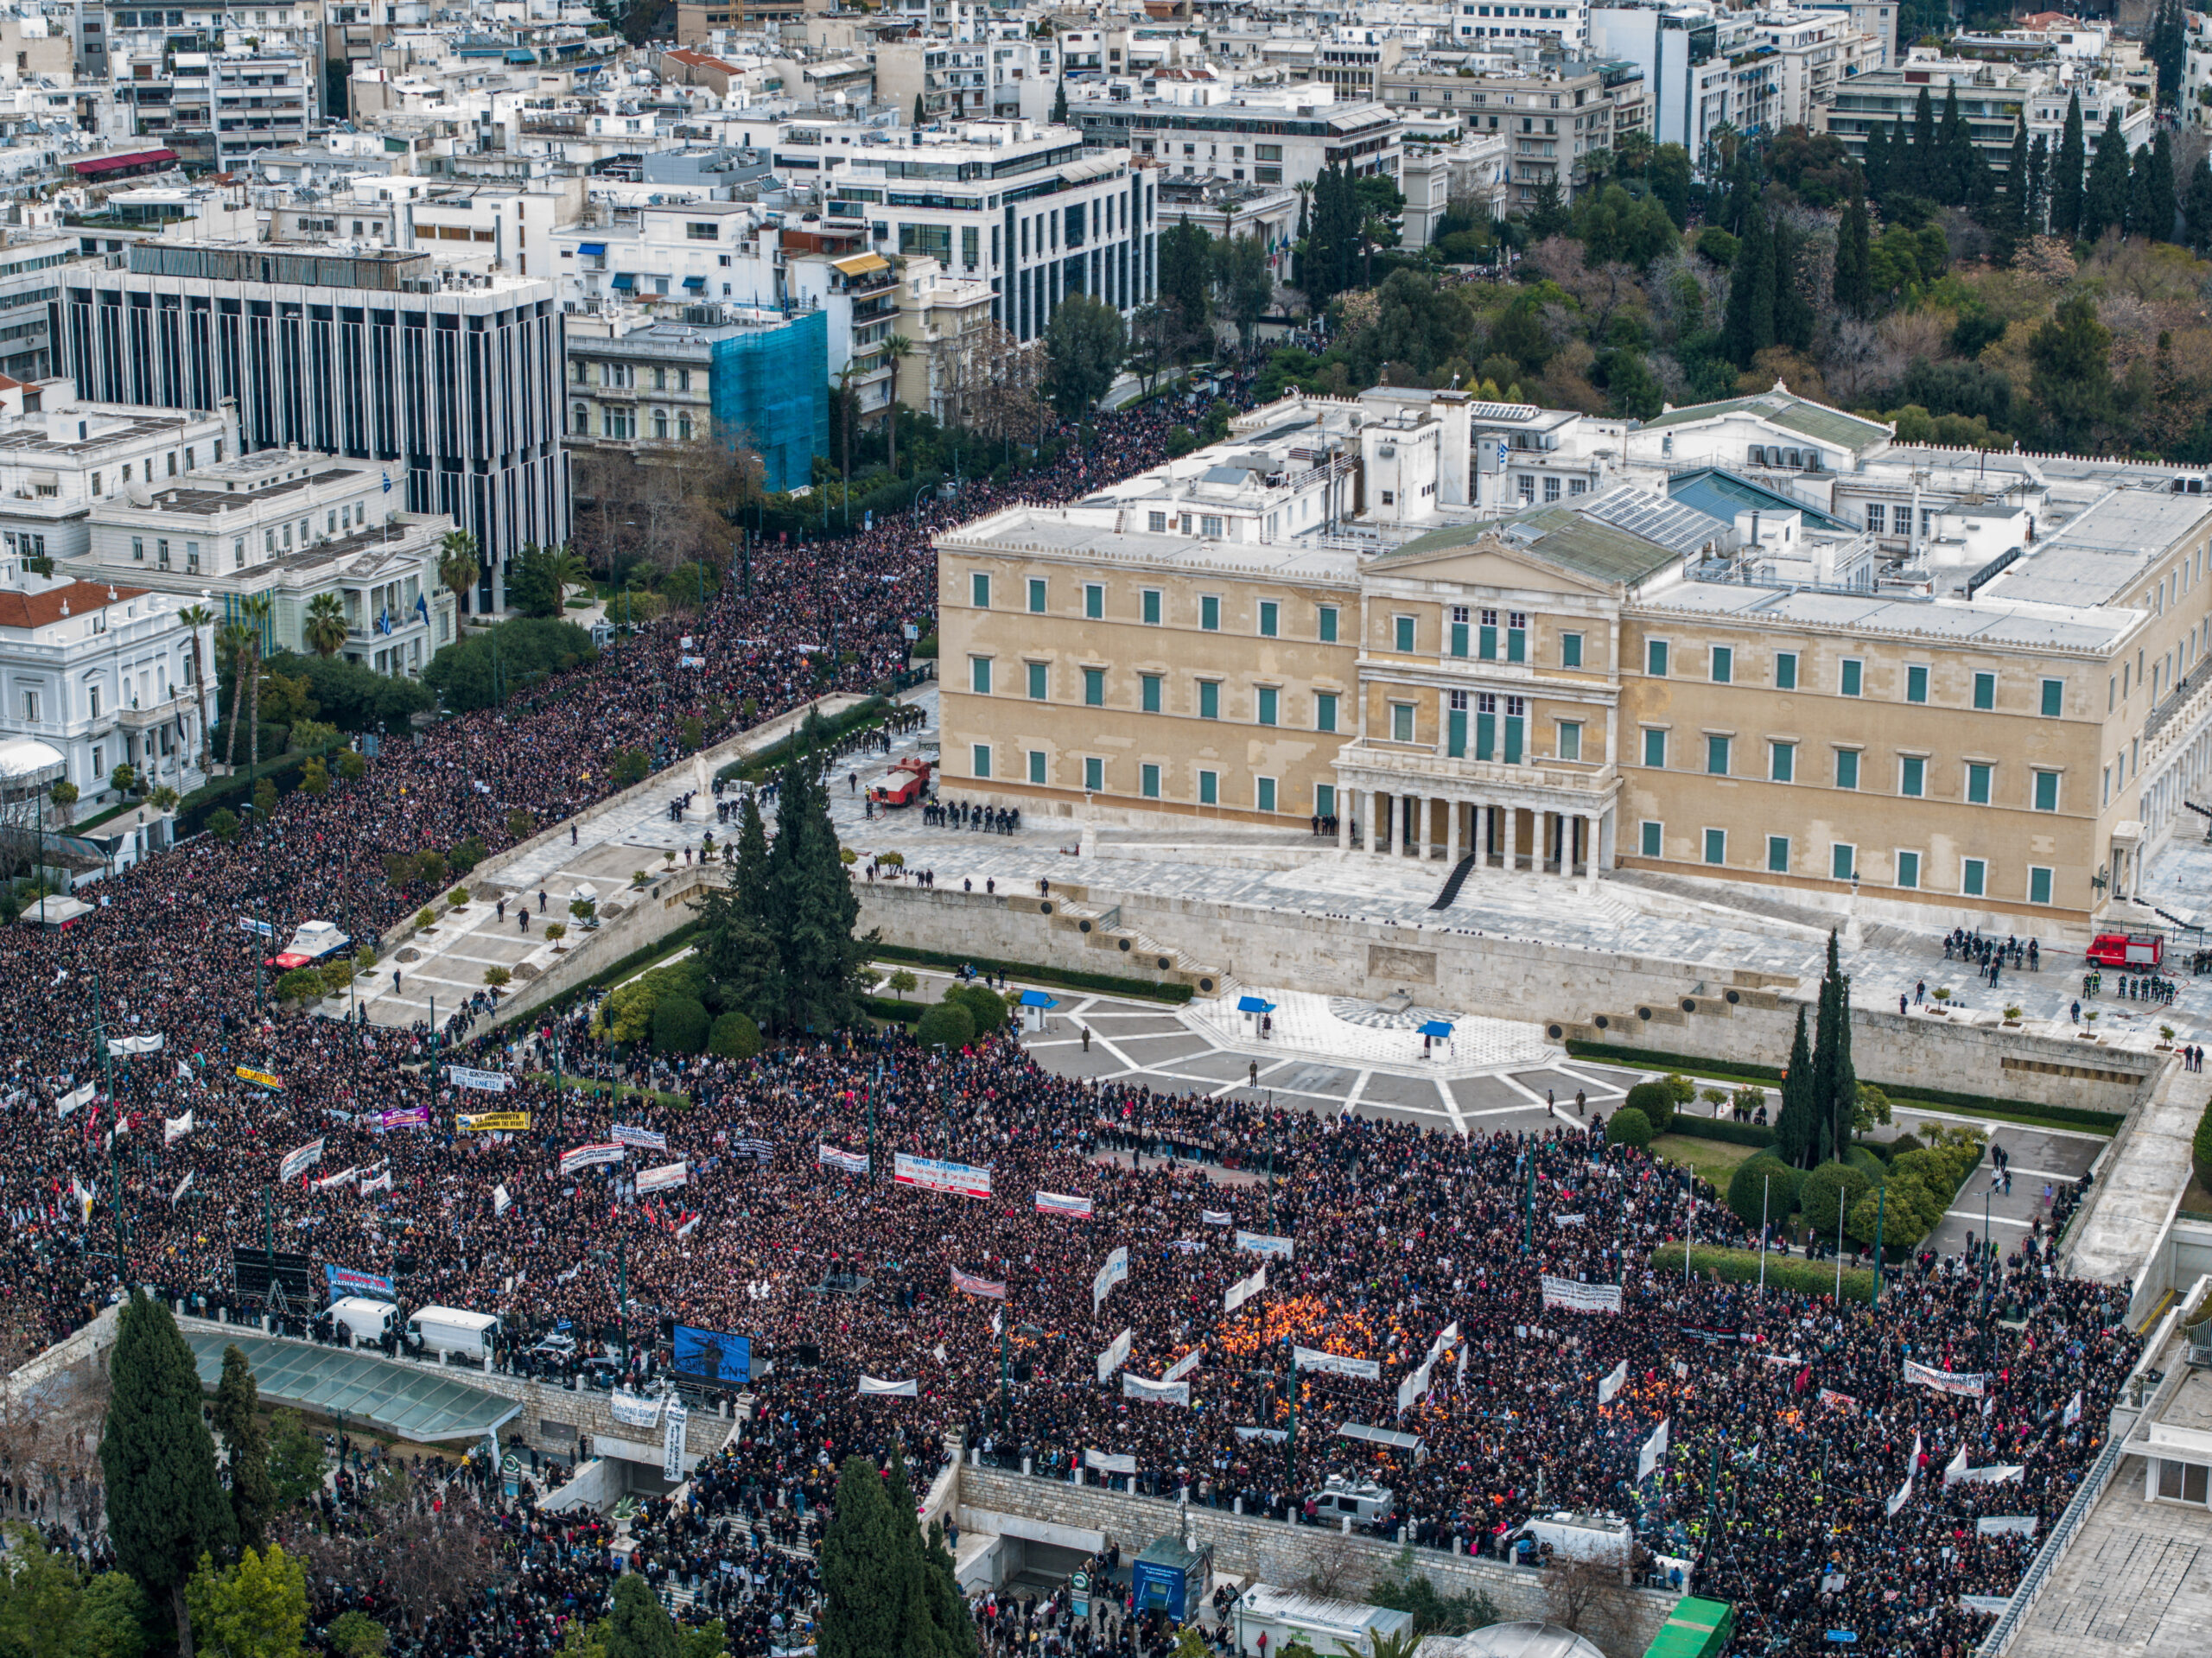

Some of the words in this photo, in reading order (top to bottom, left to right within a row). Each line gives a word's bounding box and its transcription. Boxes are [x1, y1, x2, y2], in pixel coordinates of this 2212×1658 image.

[469, 1070, 502, 1080] ΔΟΛΟΦΟΝΟΥΝ
[912, 1158, 931, 1166] ΚΑΜΙΑ
[936, 1161, 969, 1172] ΣΥΓΚΑΛΥΨΗ
